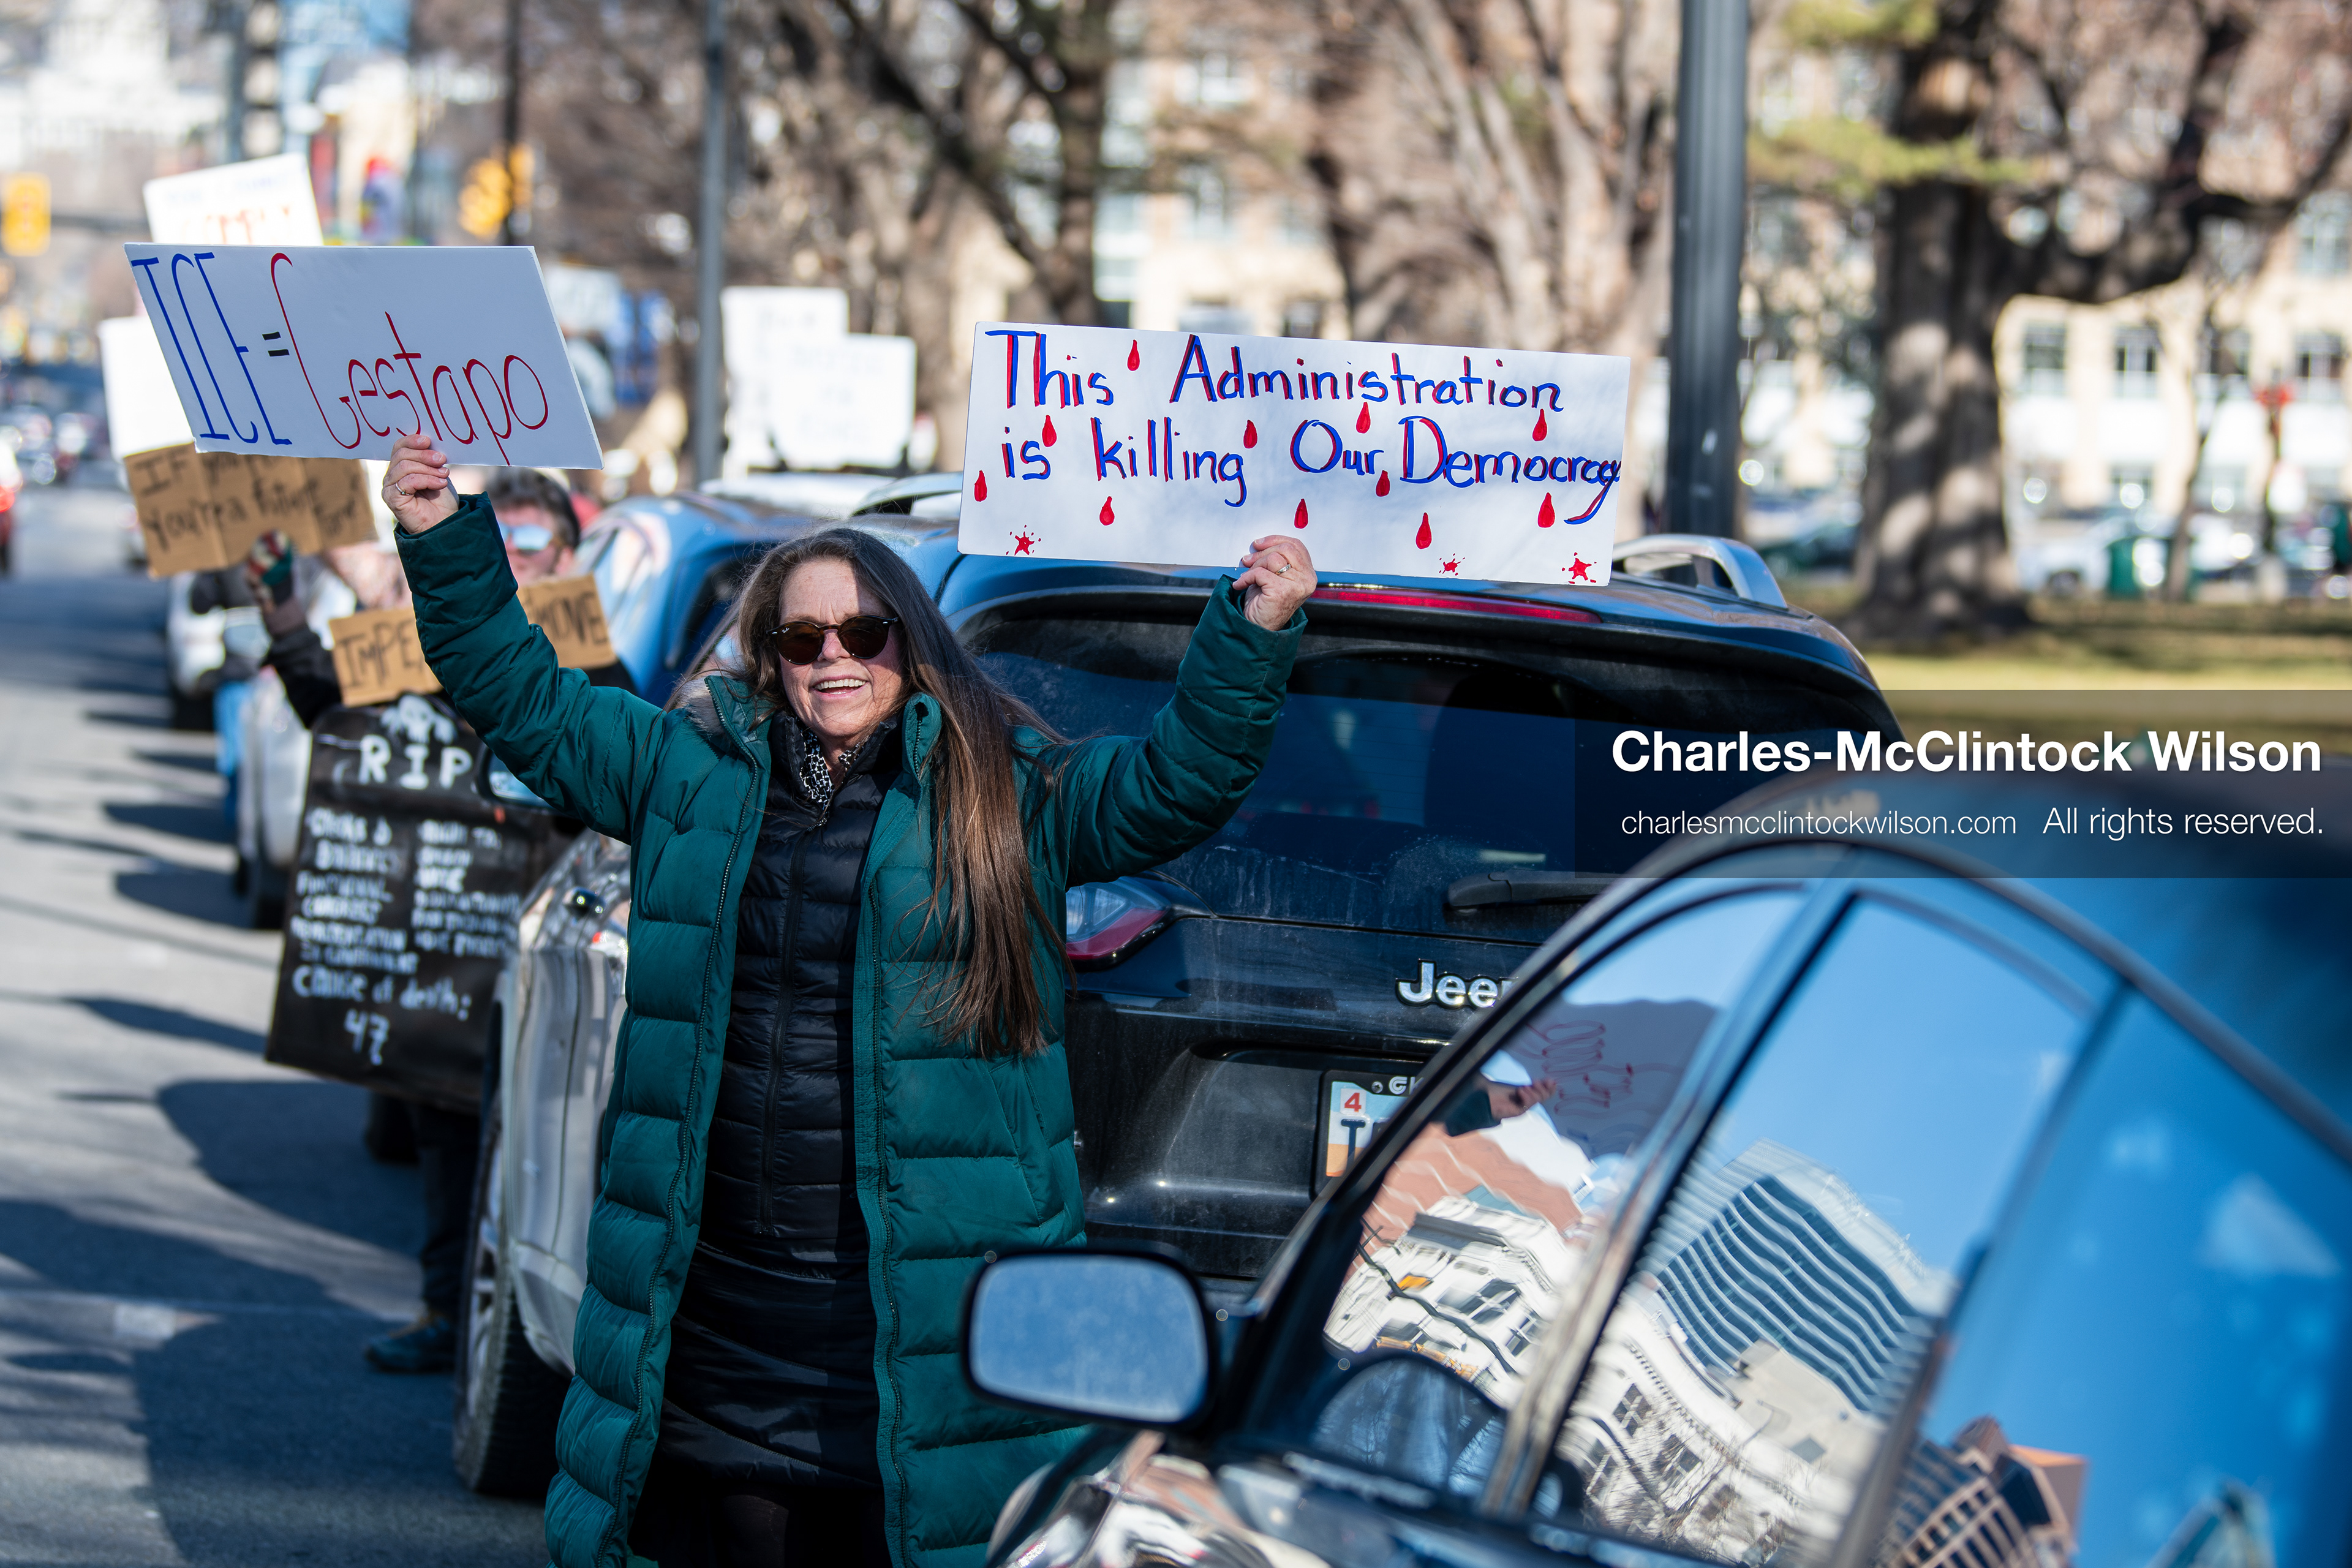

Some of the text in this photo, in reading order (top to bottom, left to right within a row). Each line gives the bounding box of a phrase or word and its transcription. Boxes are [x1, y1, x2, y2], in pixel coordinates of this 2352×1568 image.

[131, 252, 293, 445] ICE
[271, 252, 548, 466] Gestapo
[985, 330, 1564, 412] This Administration
[1002, 426, 1051, 481] is
[1090, 417, 1245, 507] killing
[1290, 419, 1384, 476] Our
[1344, 1092, 1362, 1113] 4
